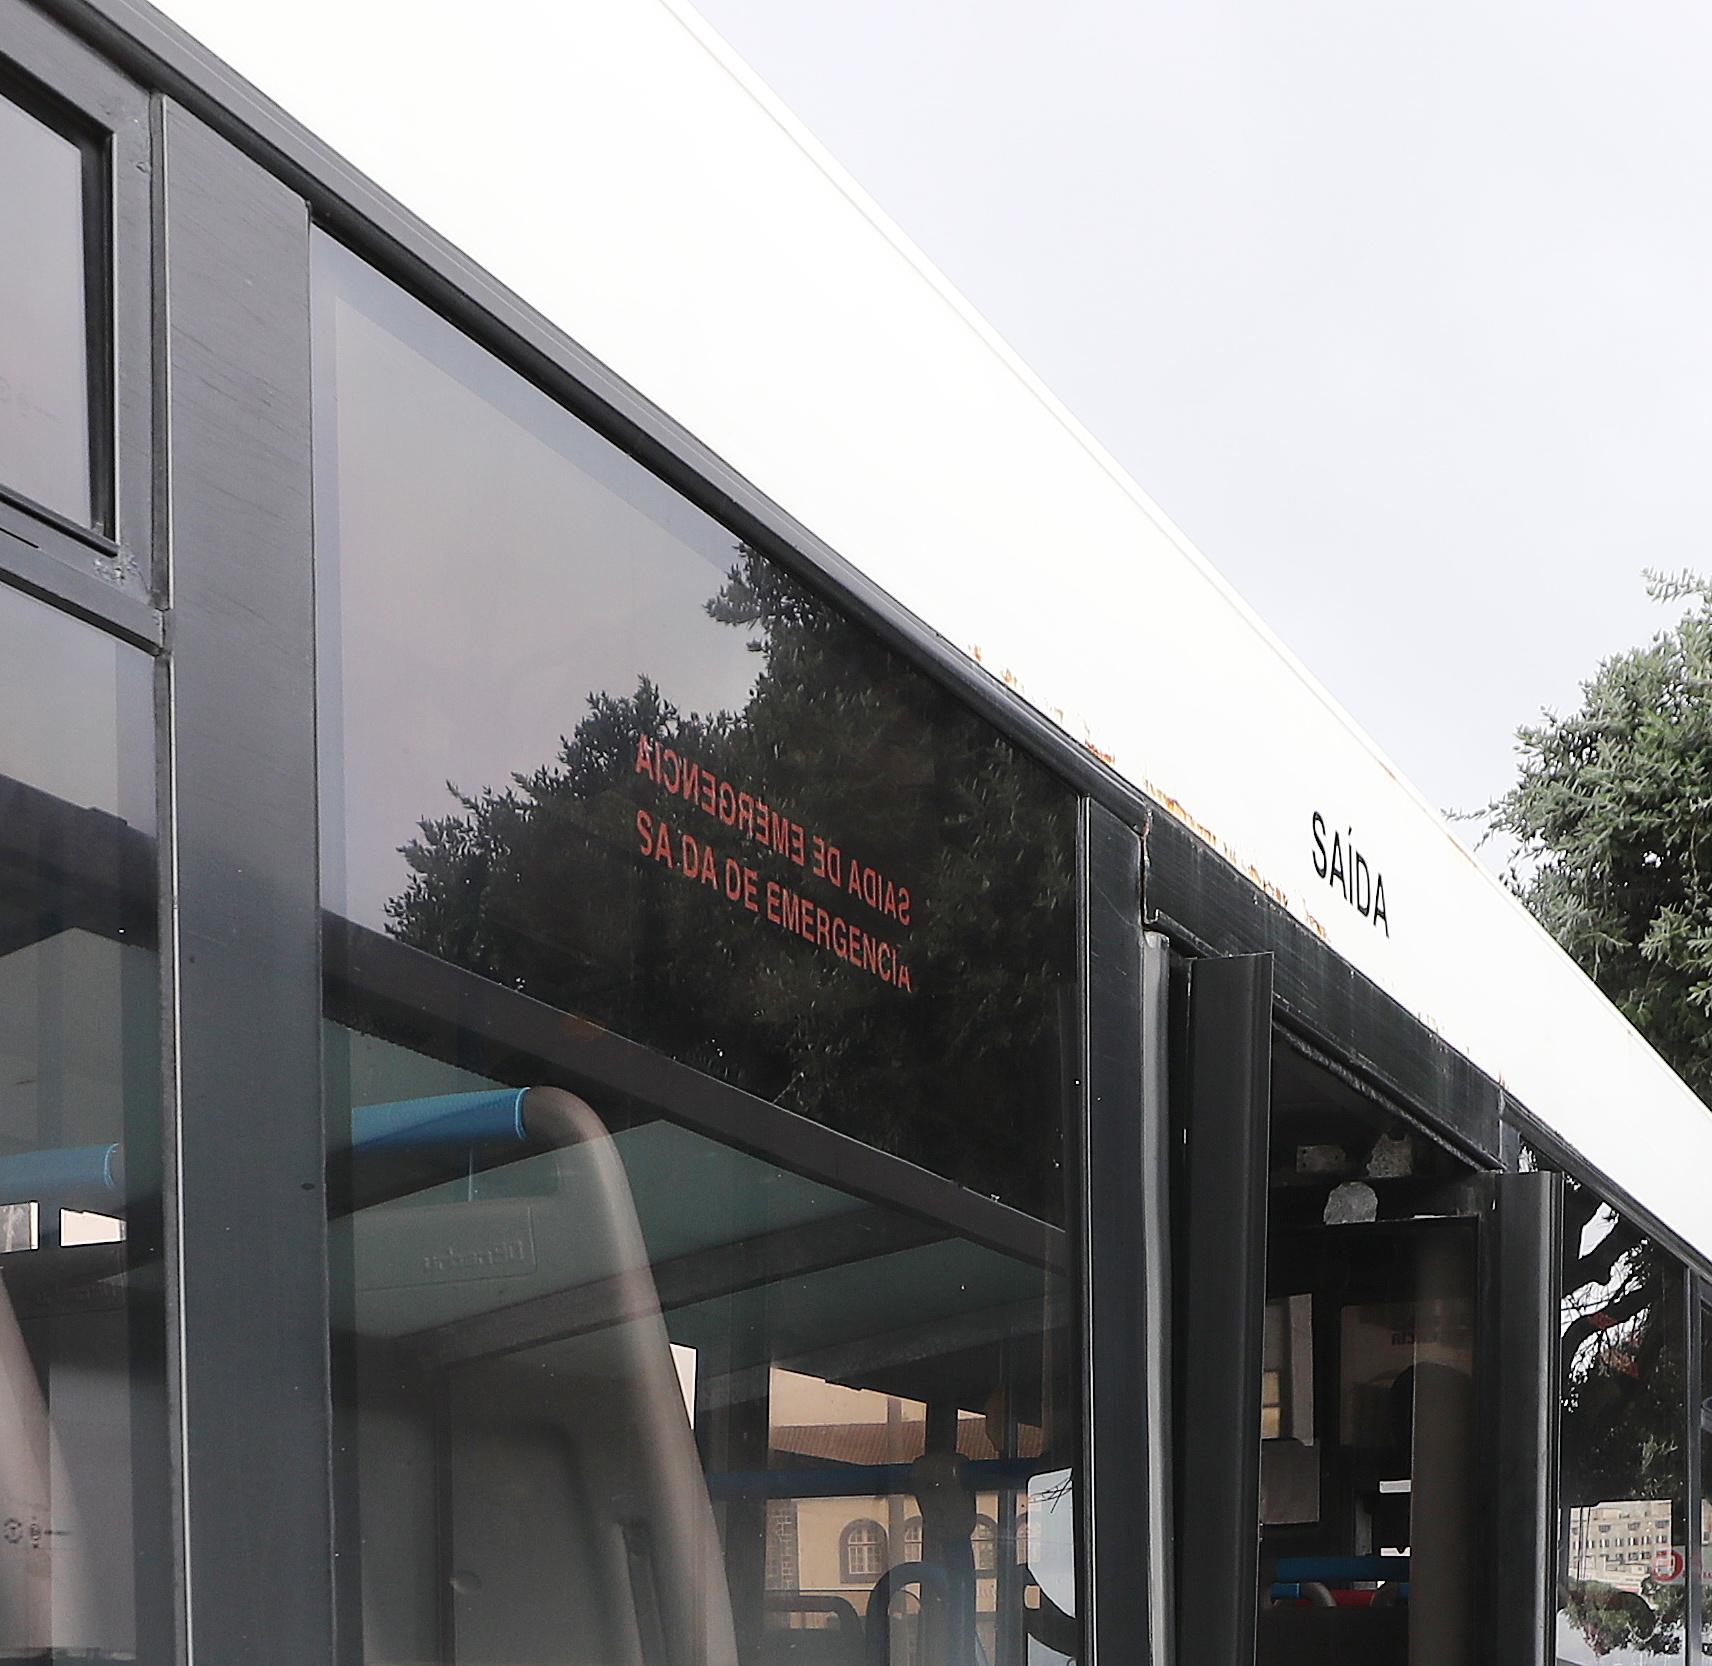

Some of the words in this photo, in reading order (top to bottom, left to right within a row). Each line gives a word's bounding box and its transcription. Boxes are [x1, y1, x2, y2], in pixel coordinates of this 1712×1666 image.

[724, 858, 759, 912] DE
[765, 881, 912, 993] EMERGENCIA
[1311, 810, 1390, 939] SAÍDA
